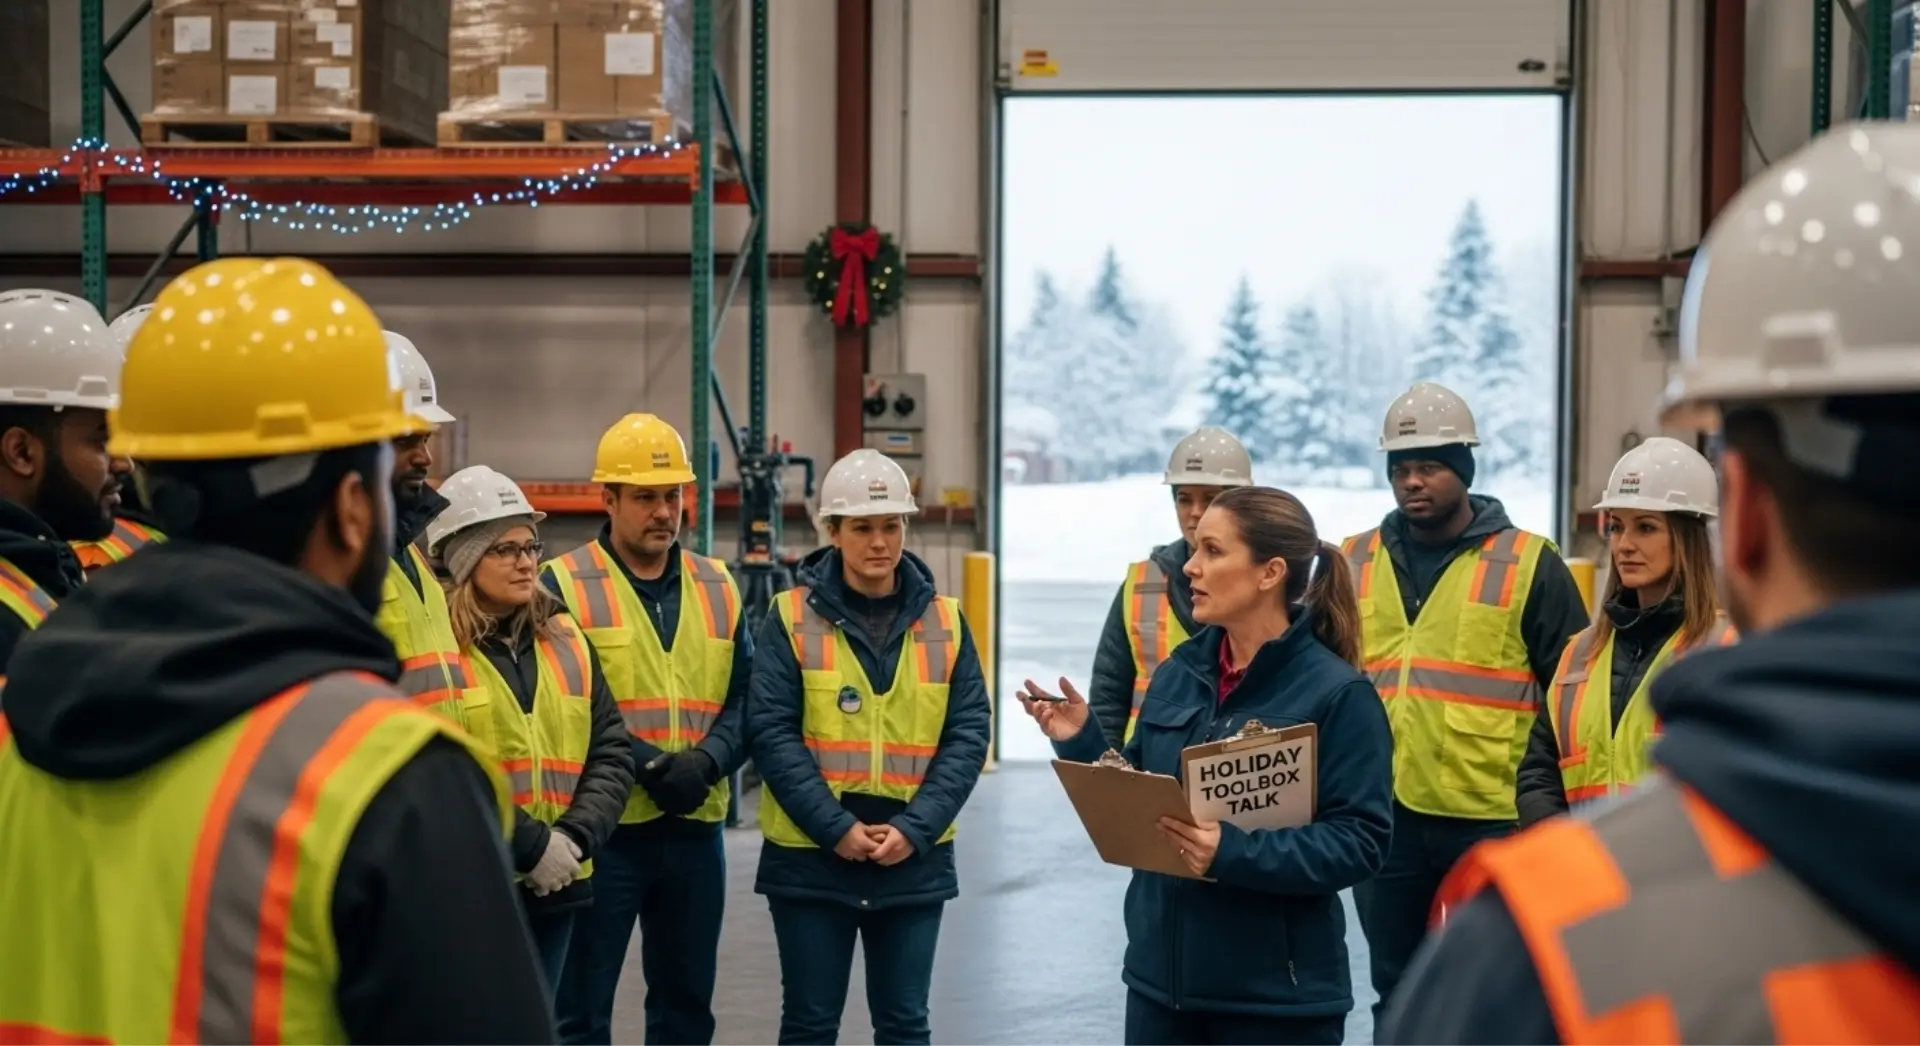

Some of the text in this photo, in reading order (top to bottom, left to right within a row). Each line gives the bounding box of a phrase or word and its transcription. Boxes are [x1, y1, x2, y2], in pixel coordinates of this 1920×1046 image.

[1201, 747, 1302, 781] HOLIDAY
[1202, 769, 1300, 801] TOOLBOX
[1228, 792, 1279, 815] TALK
